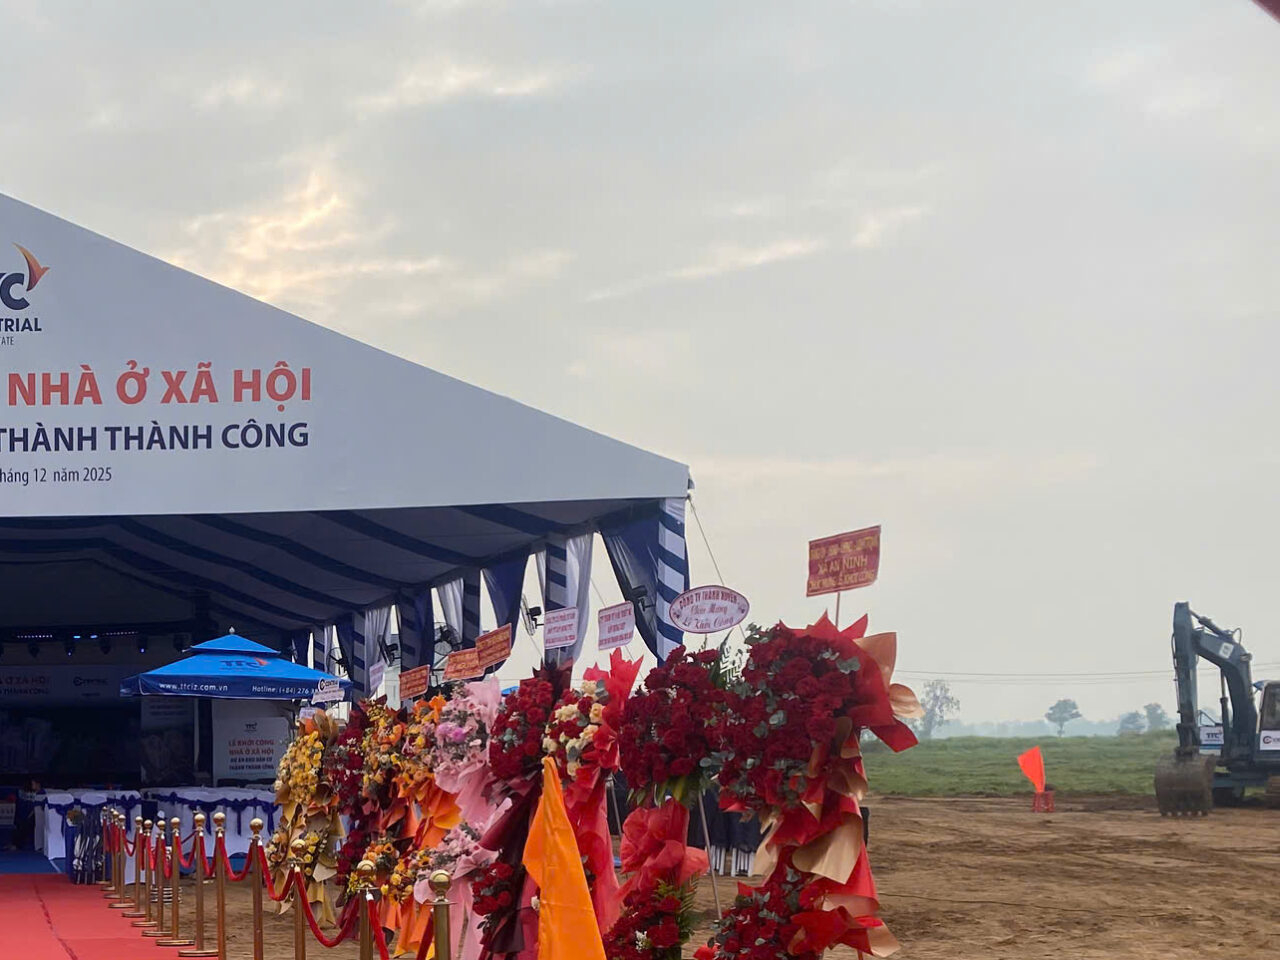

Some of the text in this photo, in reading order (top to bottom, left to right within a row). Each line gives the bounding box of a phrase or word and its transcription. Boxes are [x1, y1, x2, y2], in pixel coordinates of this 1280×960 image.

[8, 364, 103, 406] NHÀ
[116, 359, 150, 405] Ở
[160, 361, 219, 404] XÃ
[233, 360, 312, 412] HỘI
[104, 420, 212, 450] THÀNH
[222, 418, 309, 449] CÔNG
[33, 468, 47, 483] 12
[53, 467, 79, 482] năm
[83, 467, 112, 482] 2025
